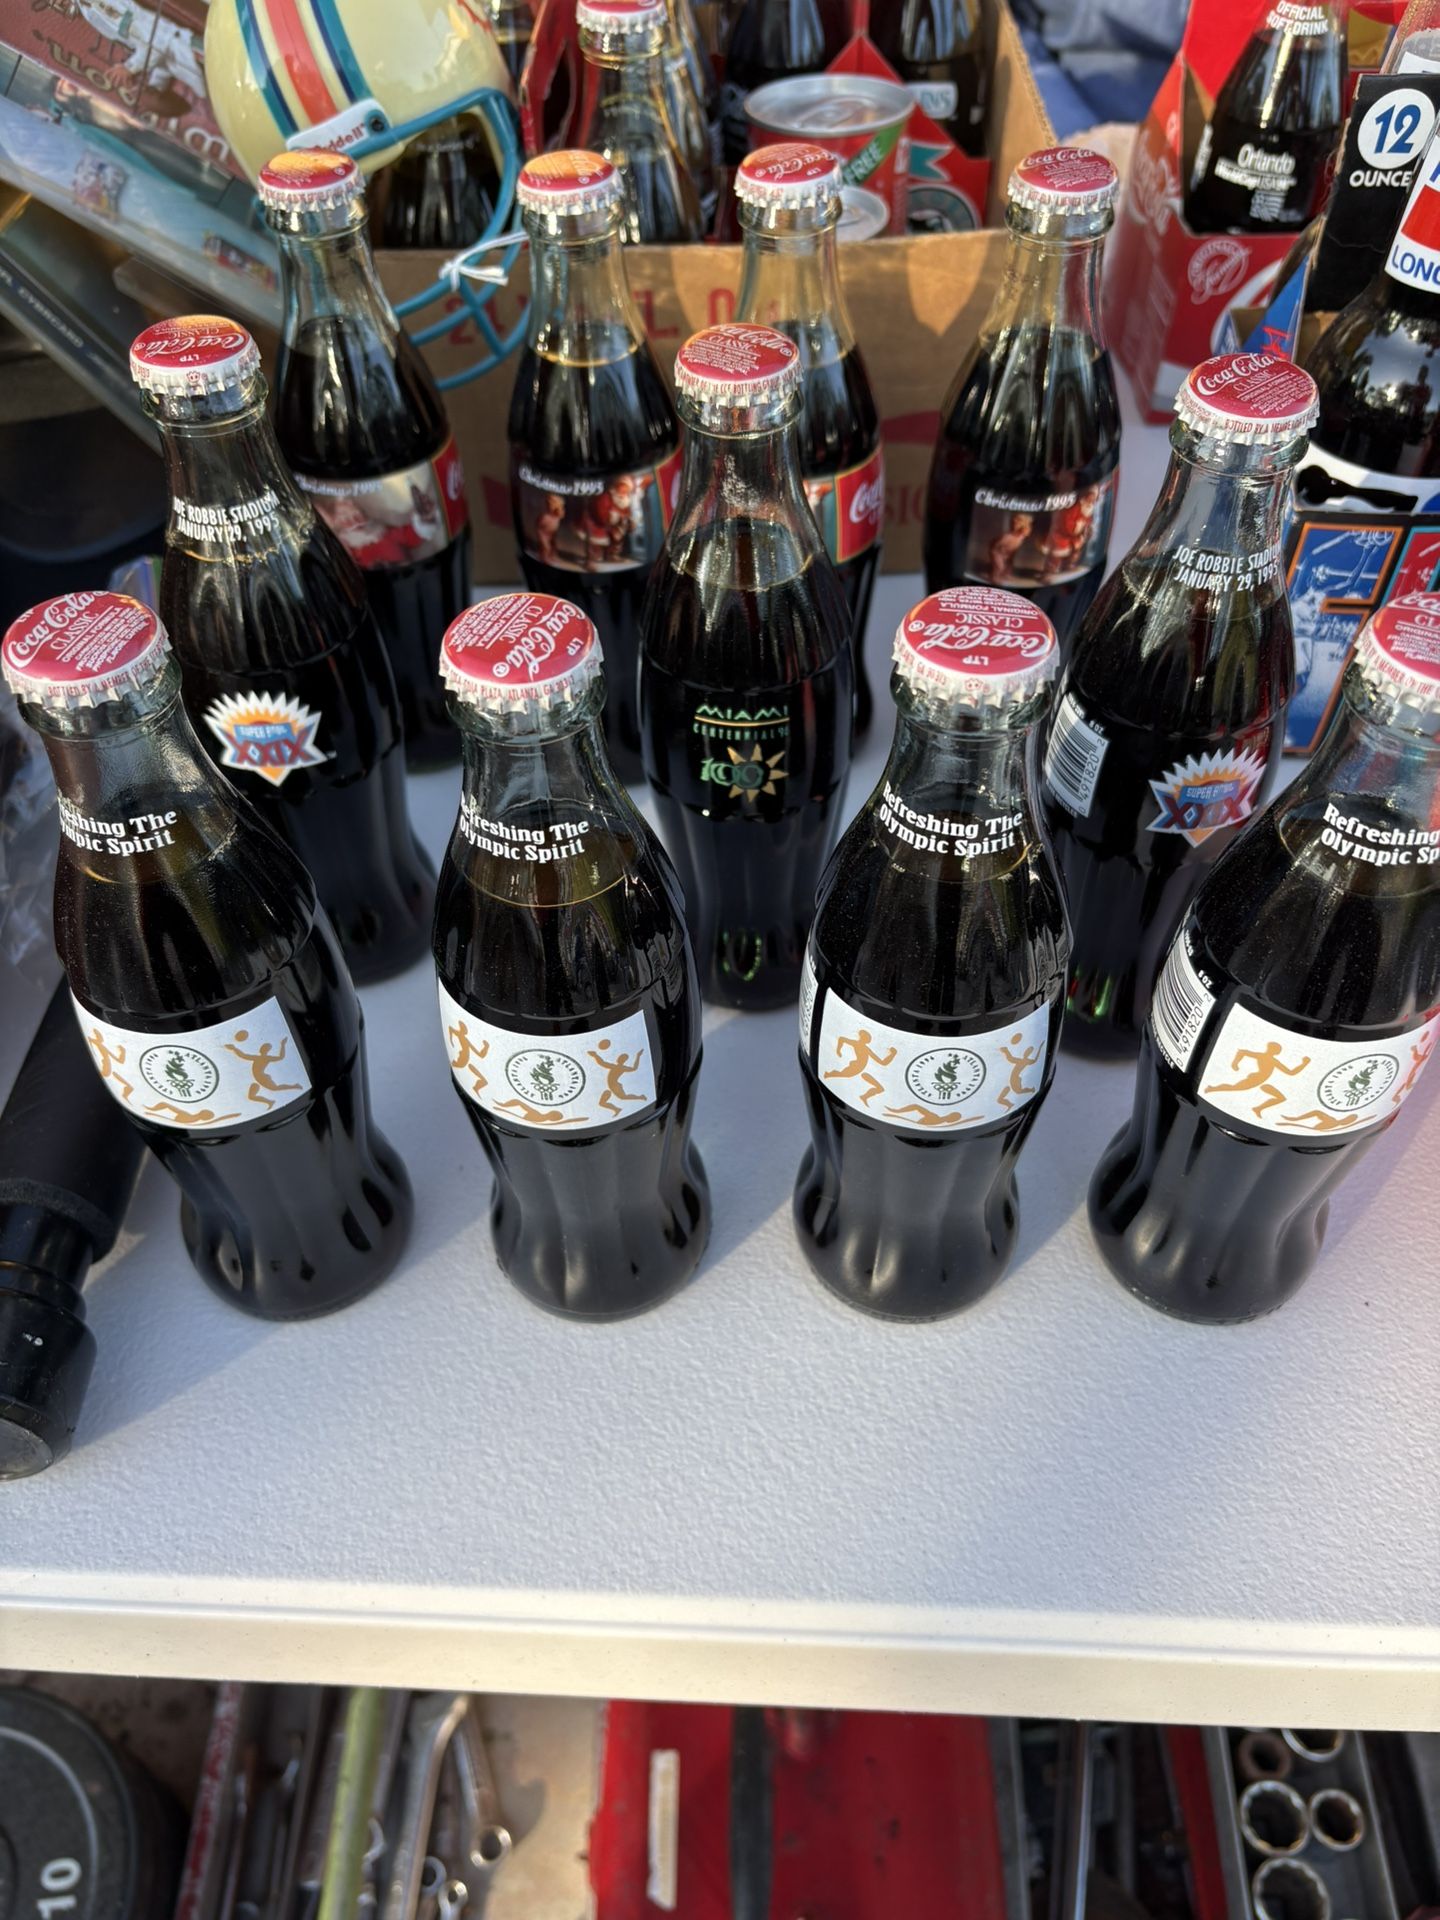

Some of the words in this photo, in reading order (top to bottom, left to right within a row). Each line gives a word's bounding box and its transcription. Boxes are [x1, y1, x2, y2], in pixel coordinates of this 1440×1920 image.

[1266, 10, 1292, 32] SOFT
[1293, 19, 1329, 36] DRINK
[1276, 0, 1325, 20] OFFICIAL
[316, 123, 363, 151] ddell
[1375, 104, 1422, 154] 12
[1238, 143, 1296, 174] Orlando
[145, 333, 244, 358] Coca-Cola
[180, 354, 199, 362] LTP
[1197, 354, 1274, 396] Coca-Cola
[1233, 369, 1275, 392] CLASSIC
[187, 505, 228, 525] ROBBIE
[230, 490, 280, 523] STADIUM
[975, 486, 1044, 512] Christmas
[1044, 490, 1077, 512] 1995
[177, 516, 223, 543] JANUARY
[247, 512, 279, 536] 1995
[1172, 545, 1198, 566] JOE
[1196, 553, 1244, 574] ROBBIE
[1174, 565, 1232, 592] JANUARY
[1237, 574, 1255, 592] 29,
[1258, 562, 1278, 585] 1995
[940, 602, 989, 611] FORMULA
[955, 613, 1023, 628] CLASSIC
[993, 605, 1039, 616] ORIGINAL
[8, 594, 95, 668] Coca-Cola
[50, 611, 99, 650] CLASSIC
[499, 605, 543, 644] CLASSIC
[62, 631, 93, 663] ORIGINAL
[506, 599, 586, 681] Coca-Cola
[566, 637, 583, 656] LTP
[916, 624, 1050, 658] Coca-Cola
[962, 655, 989, 666] LTP
[696, 705, 788, 721] MIAMI
[693, 722, 775, 740] CENTENNIAL
[1095, 723, 1105, 735] OZ
[222, 726, 316, 768] XXIX
[1080, 753, 1100, 801] 491820
[1097, 738, 1106, 747] 2
[1158, 783, 1255, 831] XXIX
[1186, 786, 1212, 800] SUPER
[129, 810, 178, 835] The
[882, 780, 979, 839] Refreshing
[985, 811, 1023, 836] The
[1323, 802, 1440, 846] Refreshing
[106, 829, 176, 857] Spirit
[460, 814, 521, 861] Olympic
[524, 838, 586, 864] Spirit
[549, 820, 590, 842] The
[879, 803, 950, 855] Olympic
[954, 831, 1015, 859] Spirit
[1321, 827, 1413, 867] Olympic
[1201, 975, 1213, 989] OZ
[1181, 1006, 1204, 1054] 491820
[36, 1857, 82, 1920] 10
